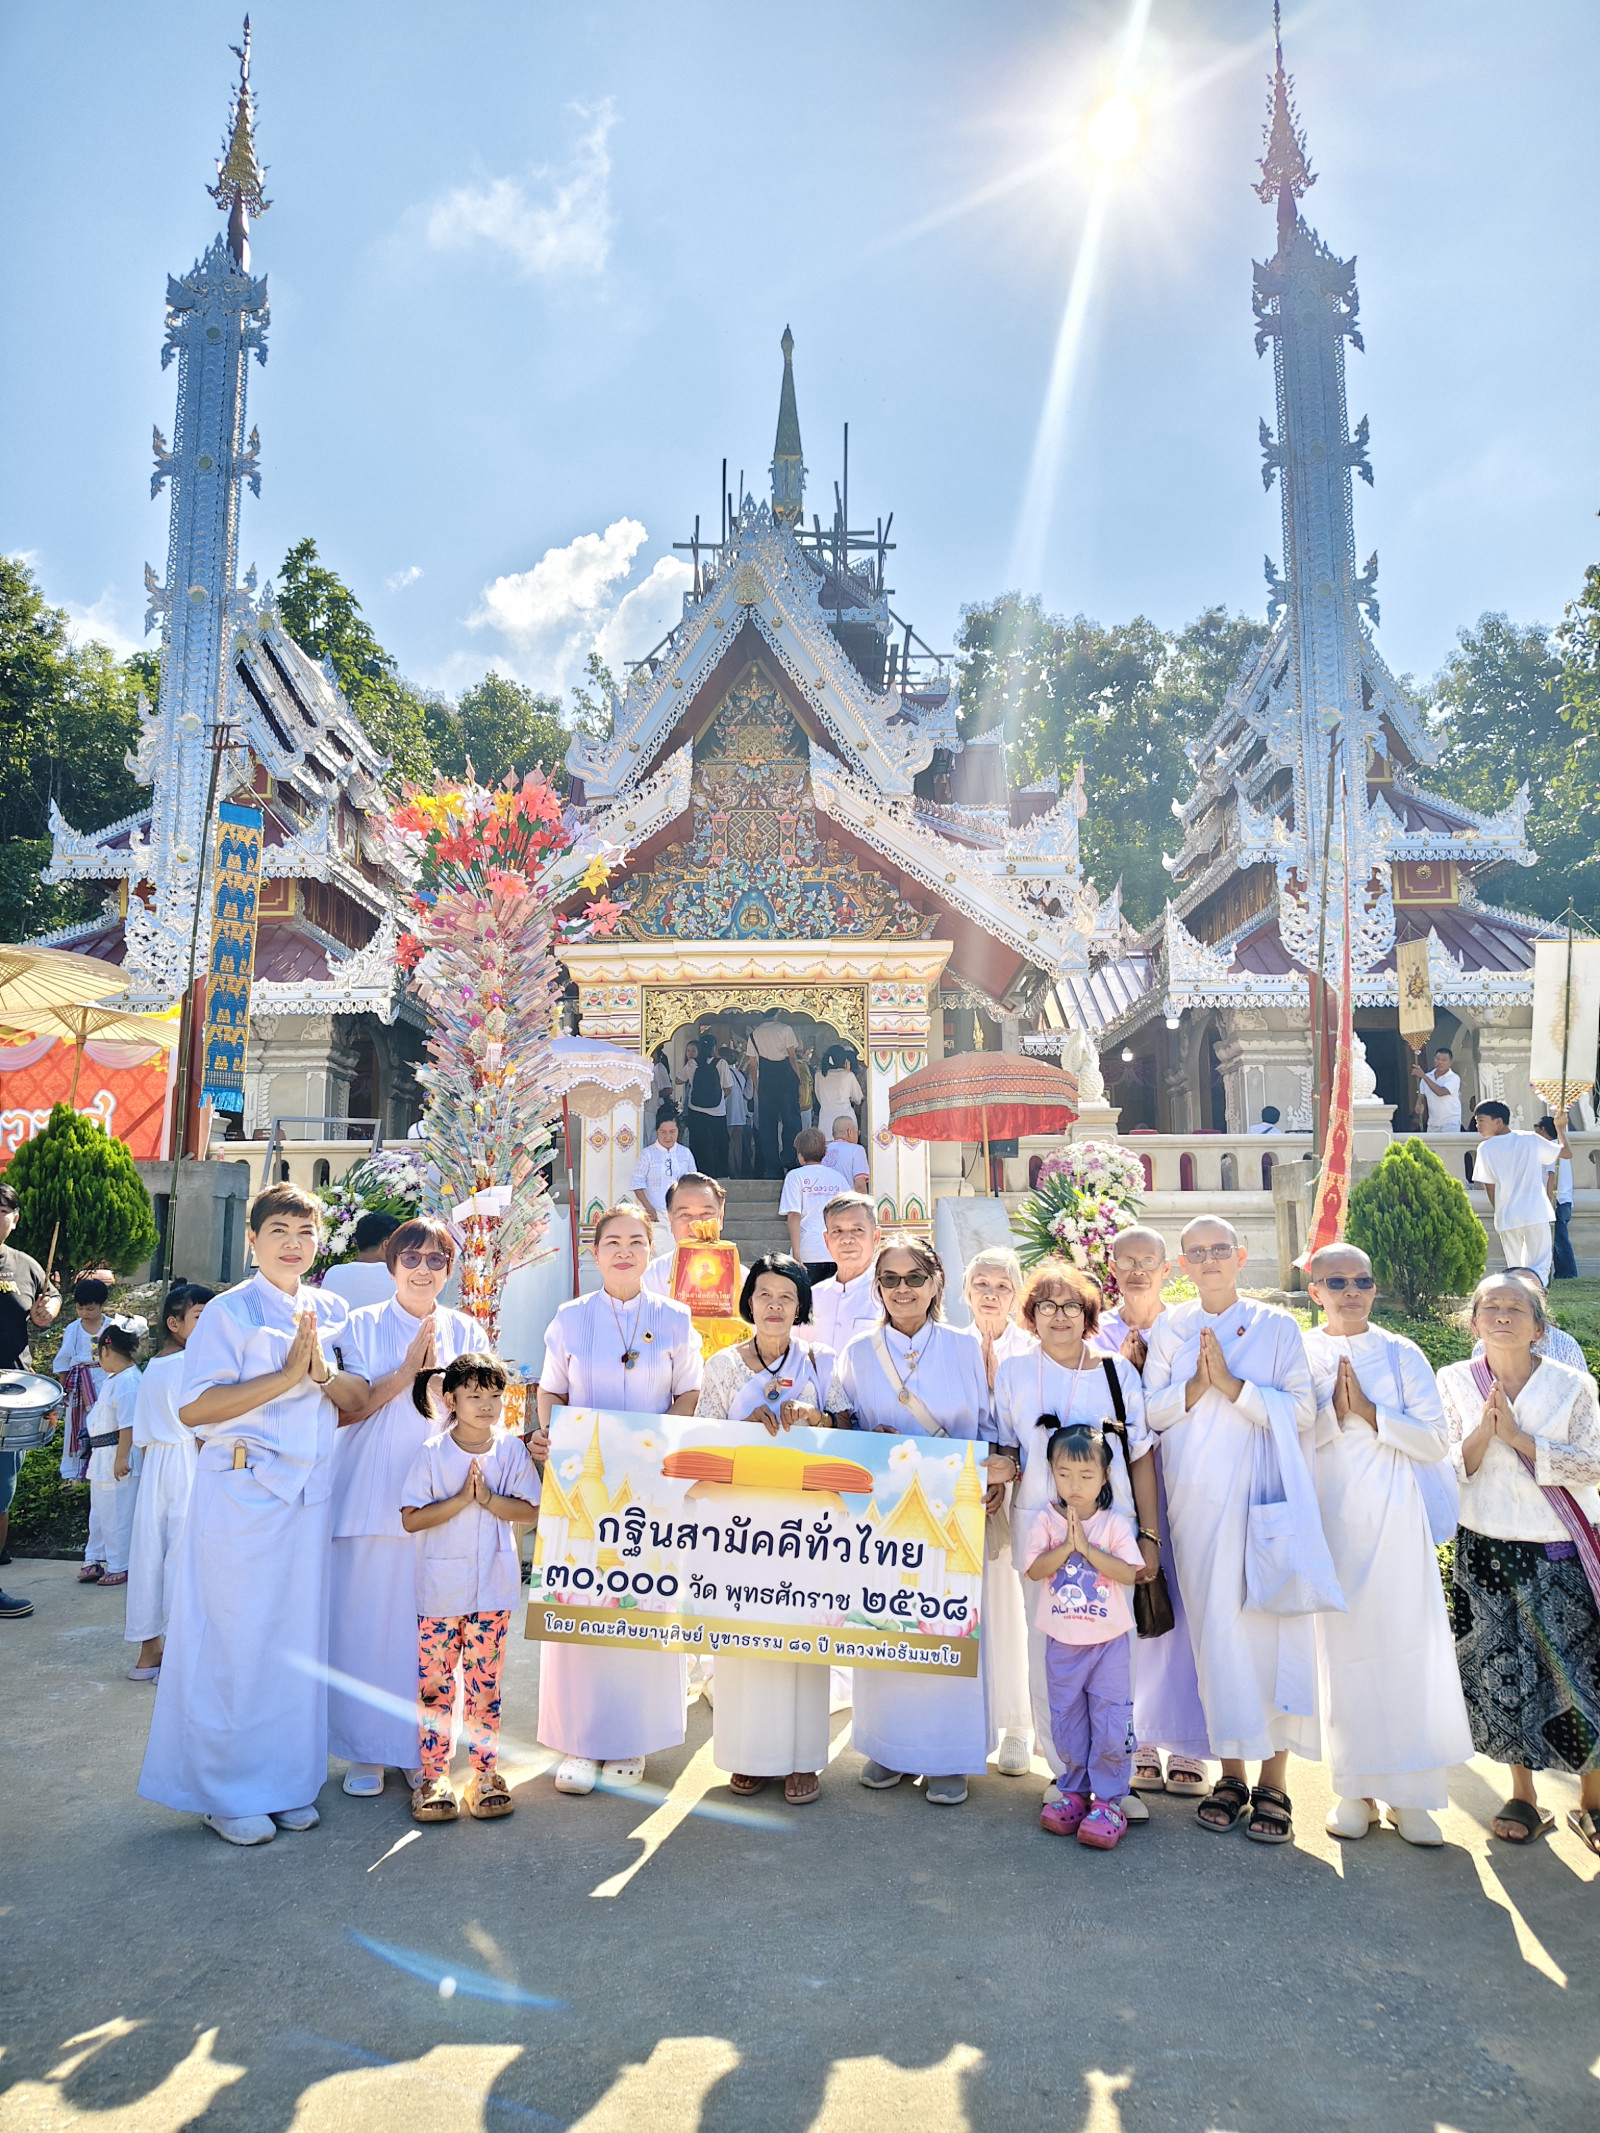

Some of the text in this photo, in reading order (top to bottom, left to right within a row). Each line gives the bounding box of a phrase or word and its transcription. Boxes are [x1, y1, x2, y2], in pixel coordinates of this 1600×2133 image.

[599, 1506, 924, 1569] กฐินสามัคคีทั่วไทย
[546, 1565, 968, 1620] ๓๐,๐๐๐ วัด พุทธศักราช ๒๕๖๘
[545, 1613, 960, 1664] โดย คณะศิษยานุศิษย์ บูชาธรรม ๘๑ ปี หลวงพ่อธัมมชโย
